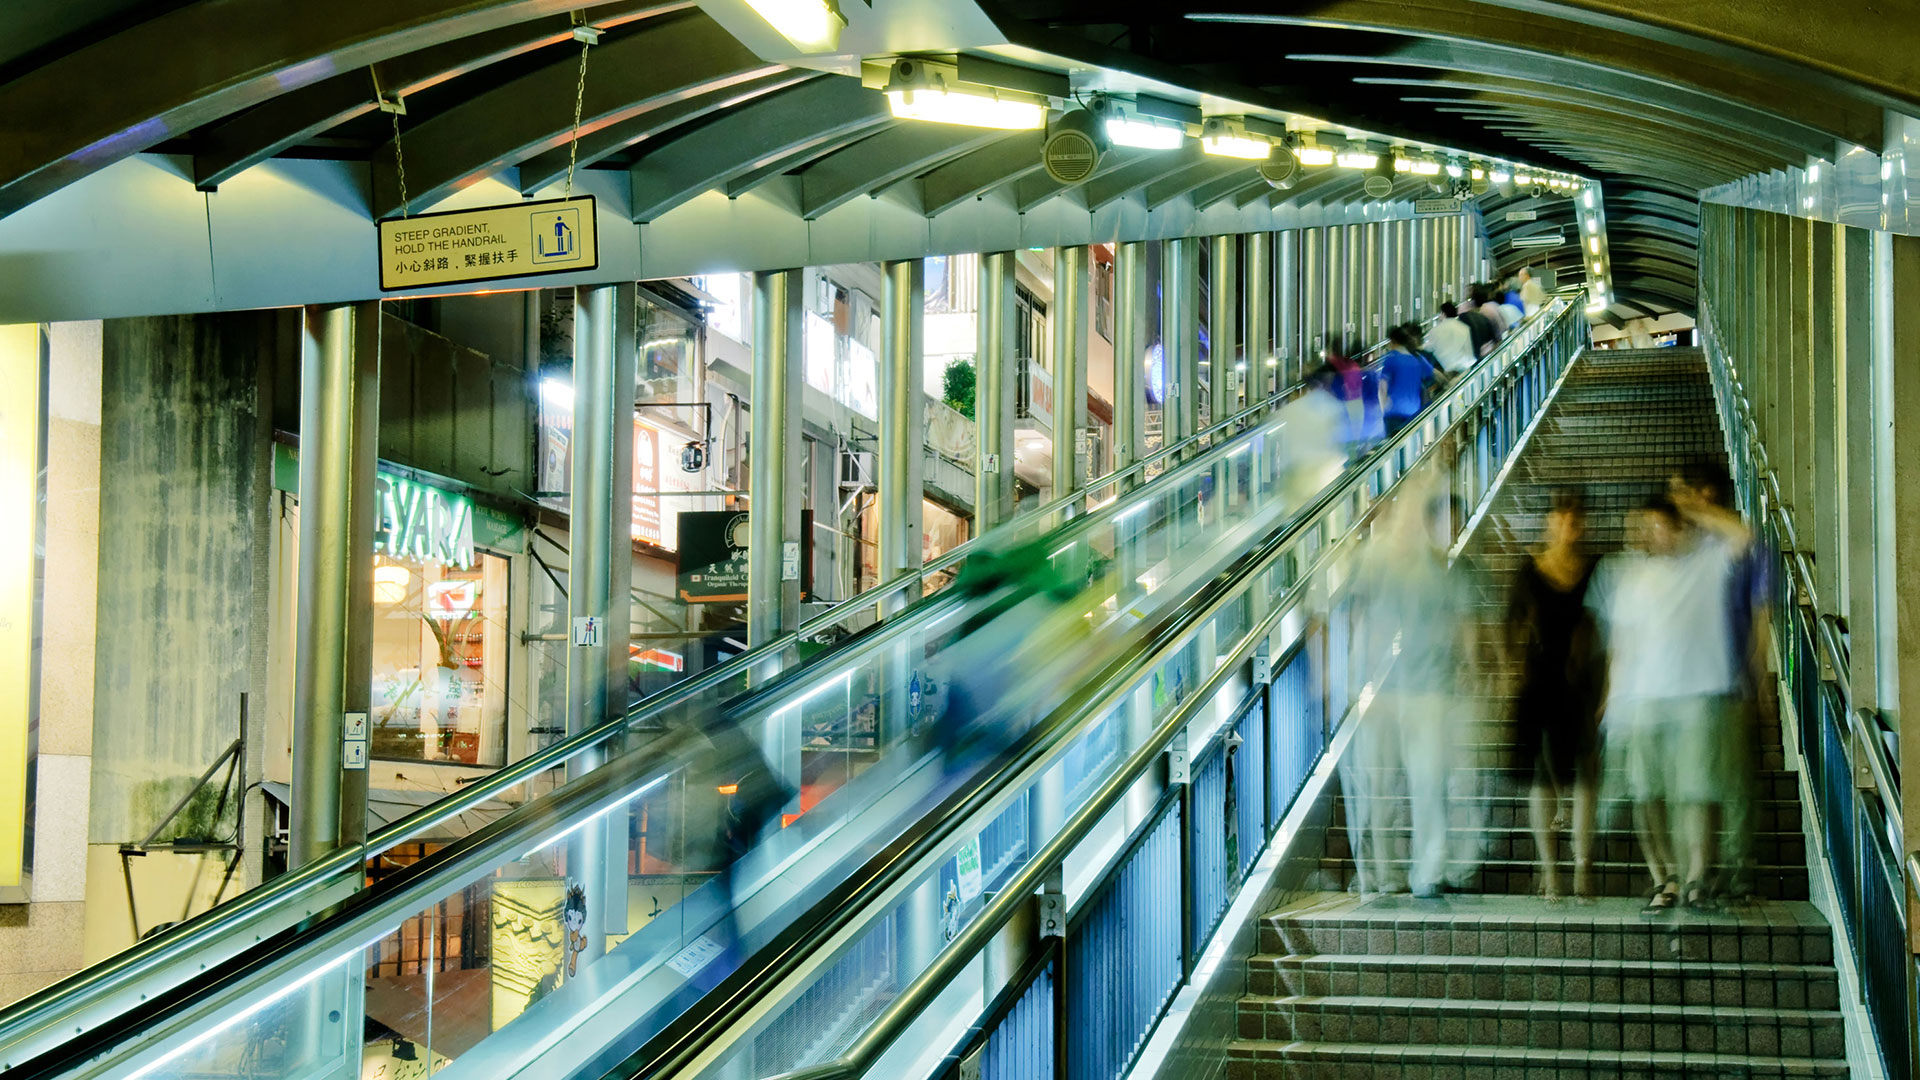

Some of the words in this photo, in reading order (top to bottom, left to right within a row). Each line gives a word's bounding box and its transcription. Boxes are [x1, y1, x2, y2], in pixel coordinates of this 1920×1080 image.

[394, 229, 430, 243] STEEP
[432, 223, 490, 237] GRADIENT,
[395, 241, 425, 255] HOLD
[428, 239, 450, 252] THE
[452, 233, 508, 249] HANDRAIL
